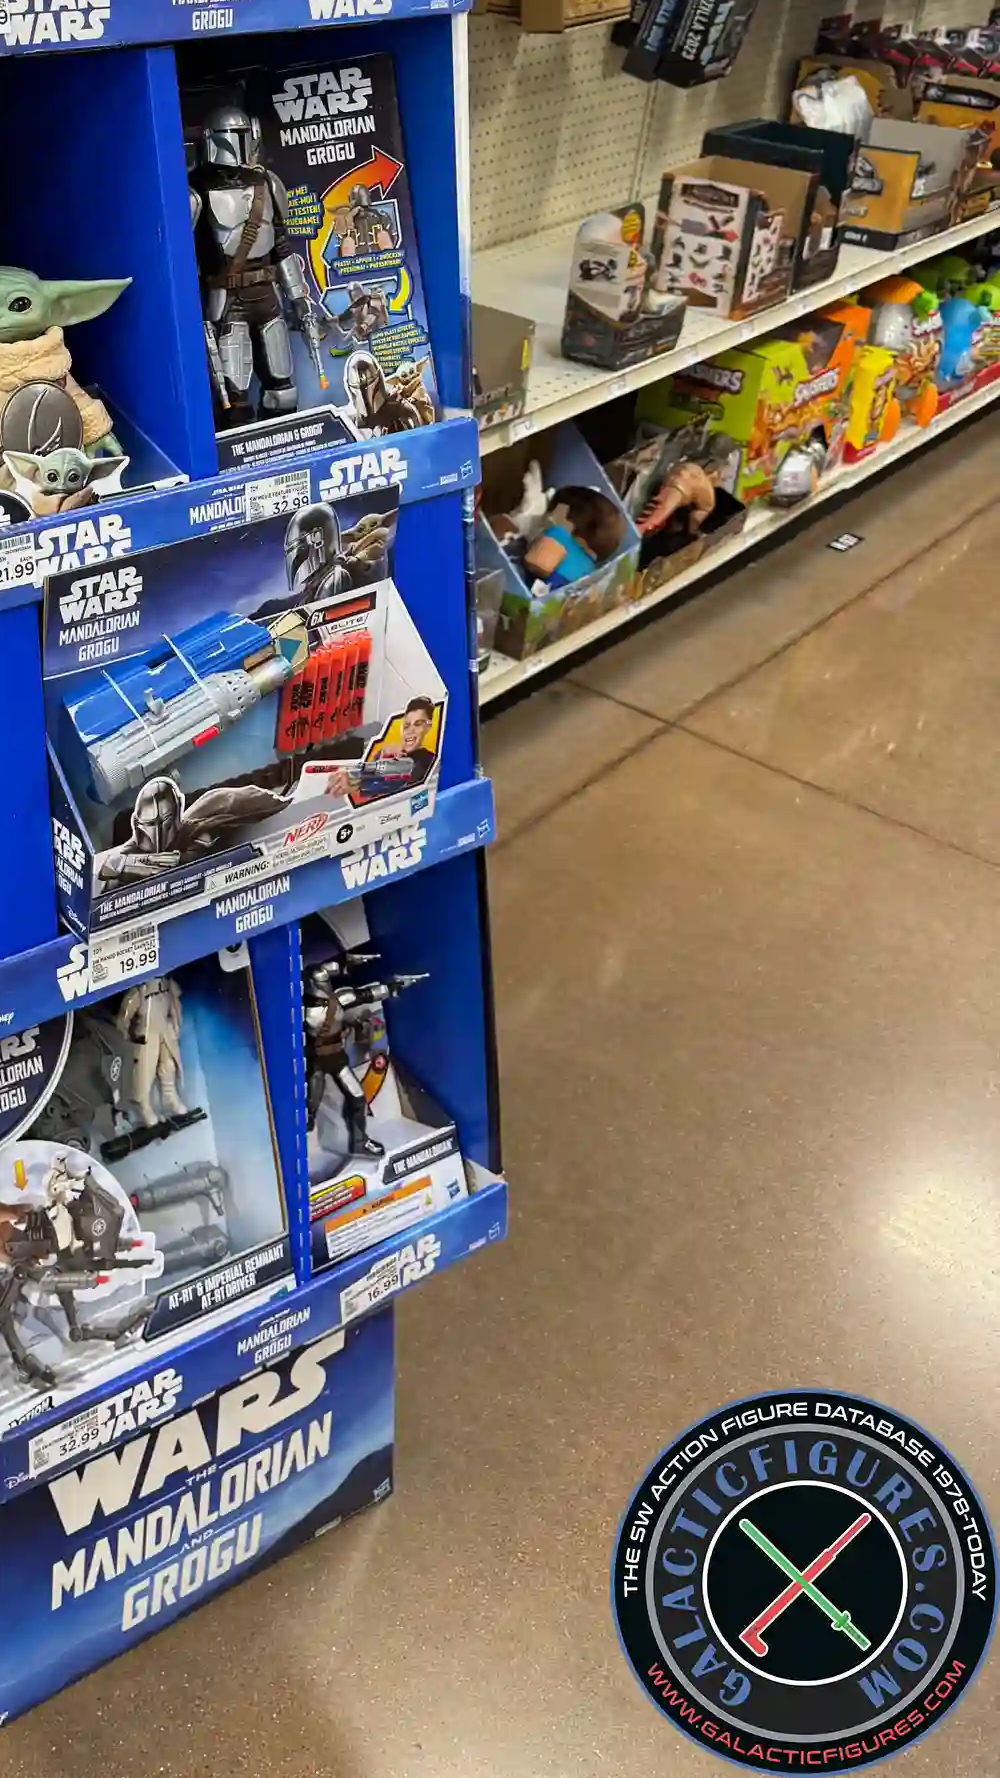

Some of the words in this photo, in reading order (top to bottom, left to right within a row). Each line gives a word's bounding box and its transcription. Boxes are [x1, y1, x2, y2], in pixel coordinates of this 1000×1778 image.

[3, 9, 110, 47] WARS
[191, 8, 234, 32] GROGU
[271, 66, 372, 110] STAR
[272, 87, 374, 126] WARS
[279, 115, 376, 148] MANDALORIAN
[305, 141, 356, 167] GROGU
[271, 494, 311, 515] 32.99
[59, 565, 143, 608] STAR
[60, 586, 142, 624] WARS
[59, 610, 141, 647] MANDALORIAN
[77, 637, 121, 662] GROGU
[282, 812, 329, 846] NERF
[223, 860, 270, 885] WARNING:
[215, 875, 291, 920] MANDALORIAN
[234, 904, 275, 935] GROGU
[119, 950, 158, 974] 19.99
[47, 1333, 346, 1537] WARS
[50, 1410, 334, 1611] MANDALORIAN
[121, 1512, 263, 1633] GROGU
